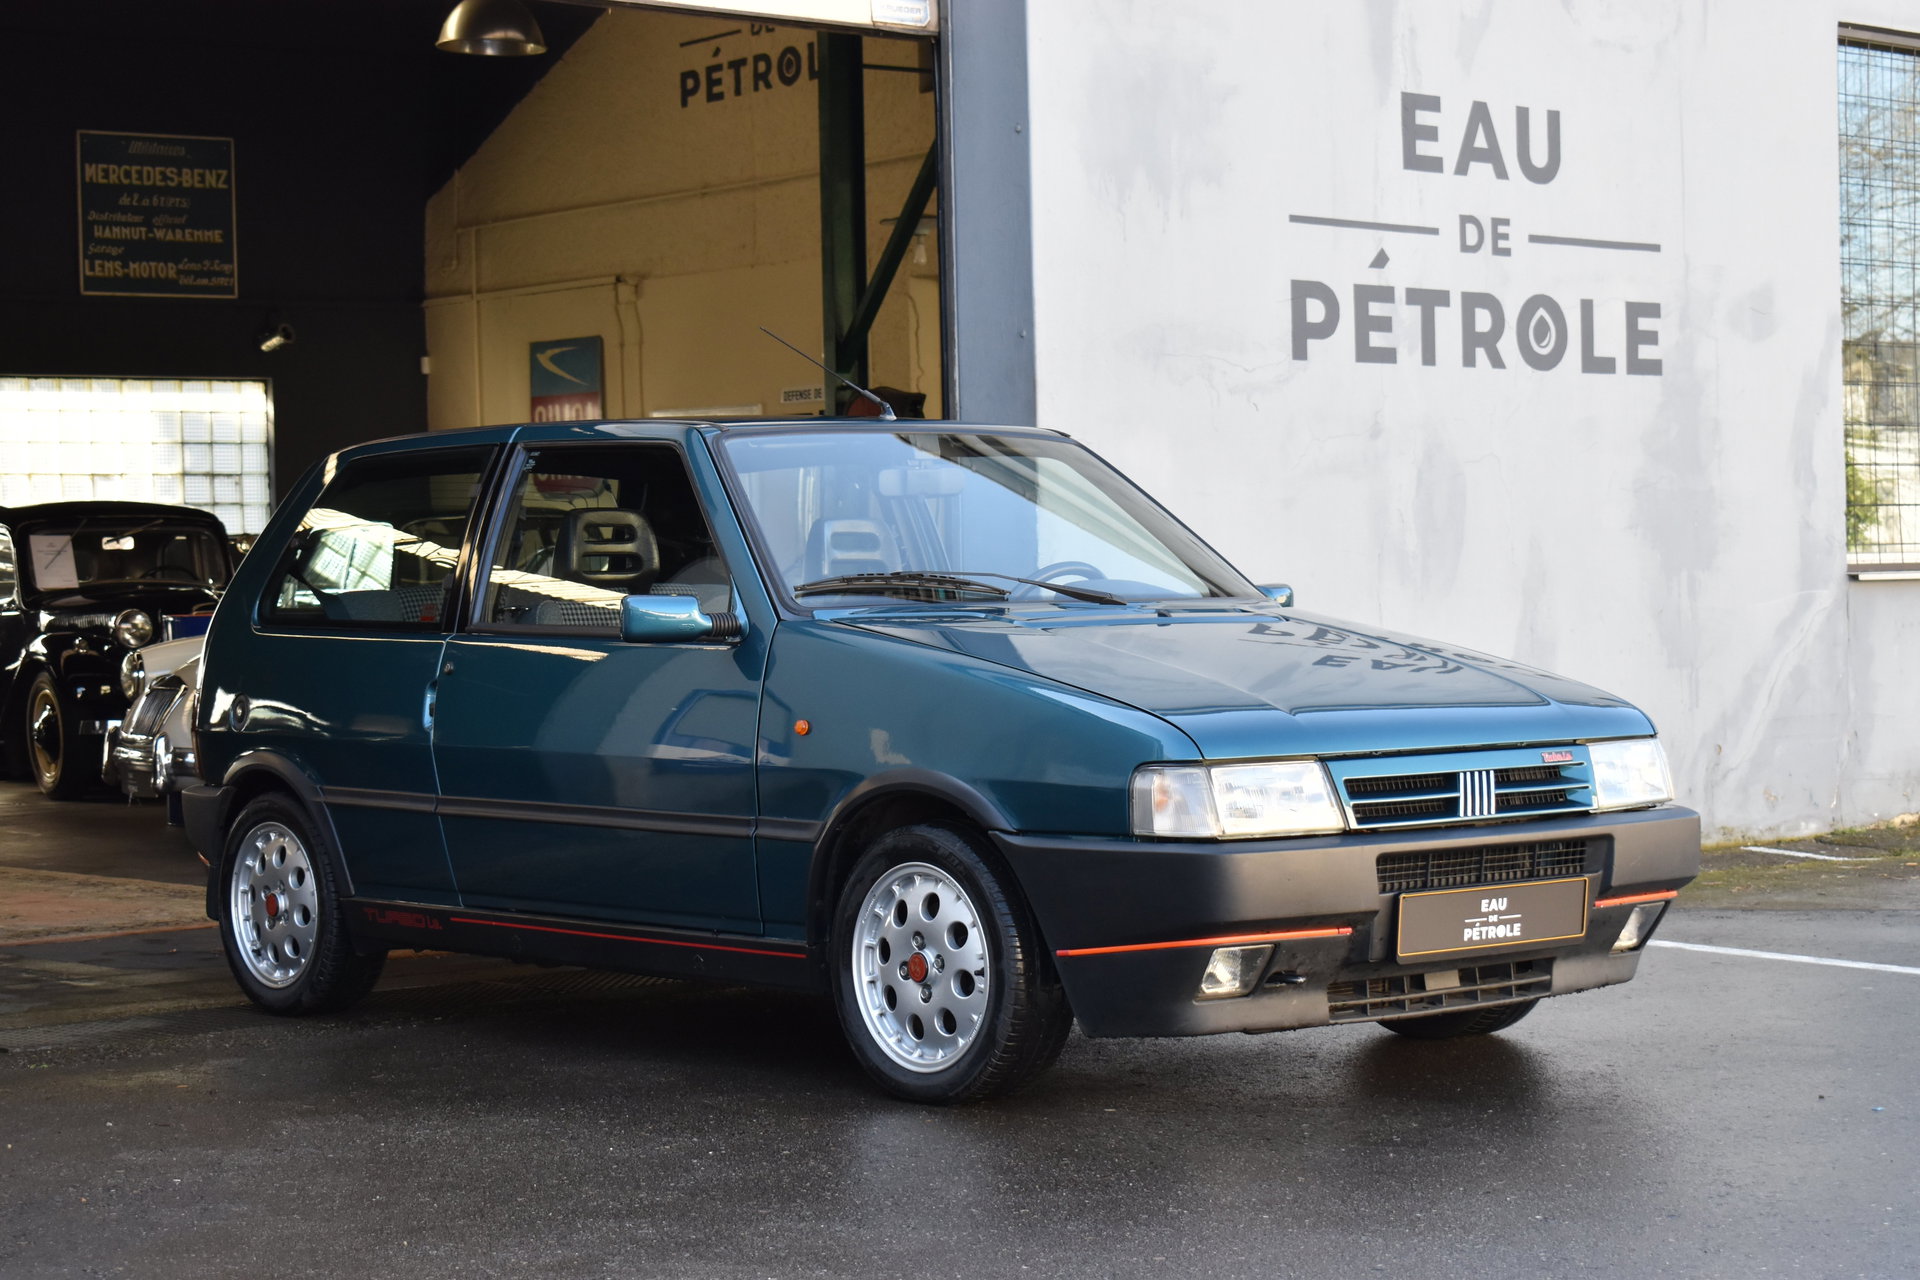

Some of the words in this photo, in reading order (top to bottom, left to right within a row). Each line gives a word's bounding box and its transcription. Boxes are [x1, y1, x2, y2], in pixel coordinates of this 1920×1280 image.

[680, 42, 820, 108] PÉTROL
[1401, 91, 1561, 185] EAU
[84, 163, 228, 188] MERCEDES-BENZ
[94, 225, 223, 243] HANNUT-WAREMME
[1459, 214, 1512, 257] DE
[84, 258, 178, 280] LENS-MOTOR
[1290, 247, 1663, 376] PÉTROLE
[784, 389, 811, 401] DEFENSE
[1481, 897, 1508, 912] EAU
[1488, 914, 1498, 923] DE
[1463, 922, 1522, 942] PÉTROLE
